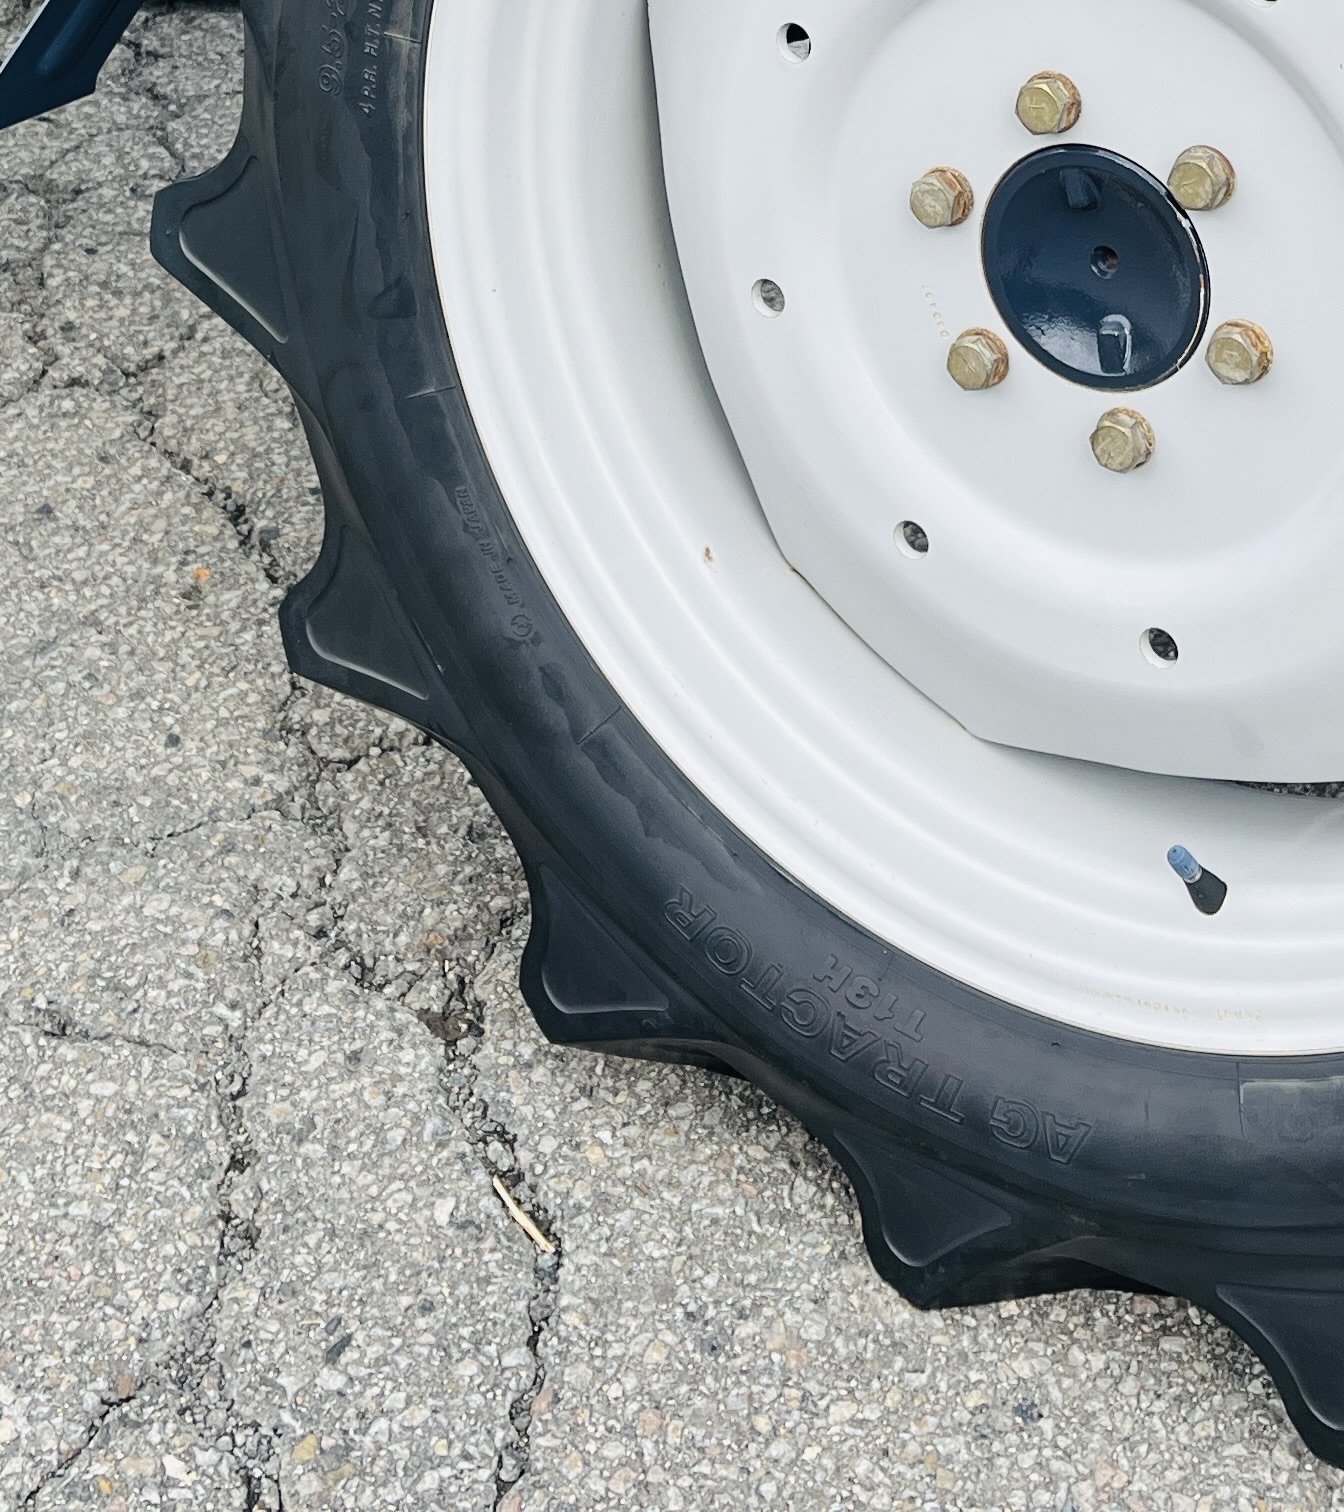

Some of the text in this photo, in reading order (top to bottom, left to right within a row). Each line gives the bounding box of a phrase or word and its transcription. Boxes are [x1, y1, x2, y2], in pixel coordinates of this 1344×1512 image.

[662, 886, 1091, 1165] AG TRACTOR
[813, 953, 927, 1041] T13H
